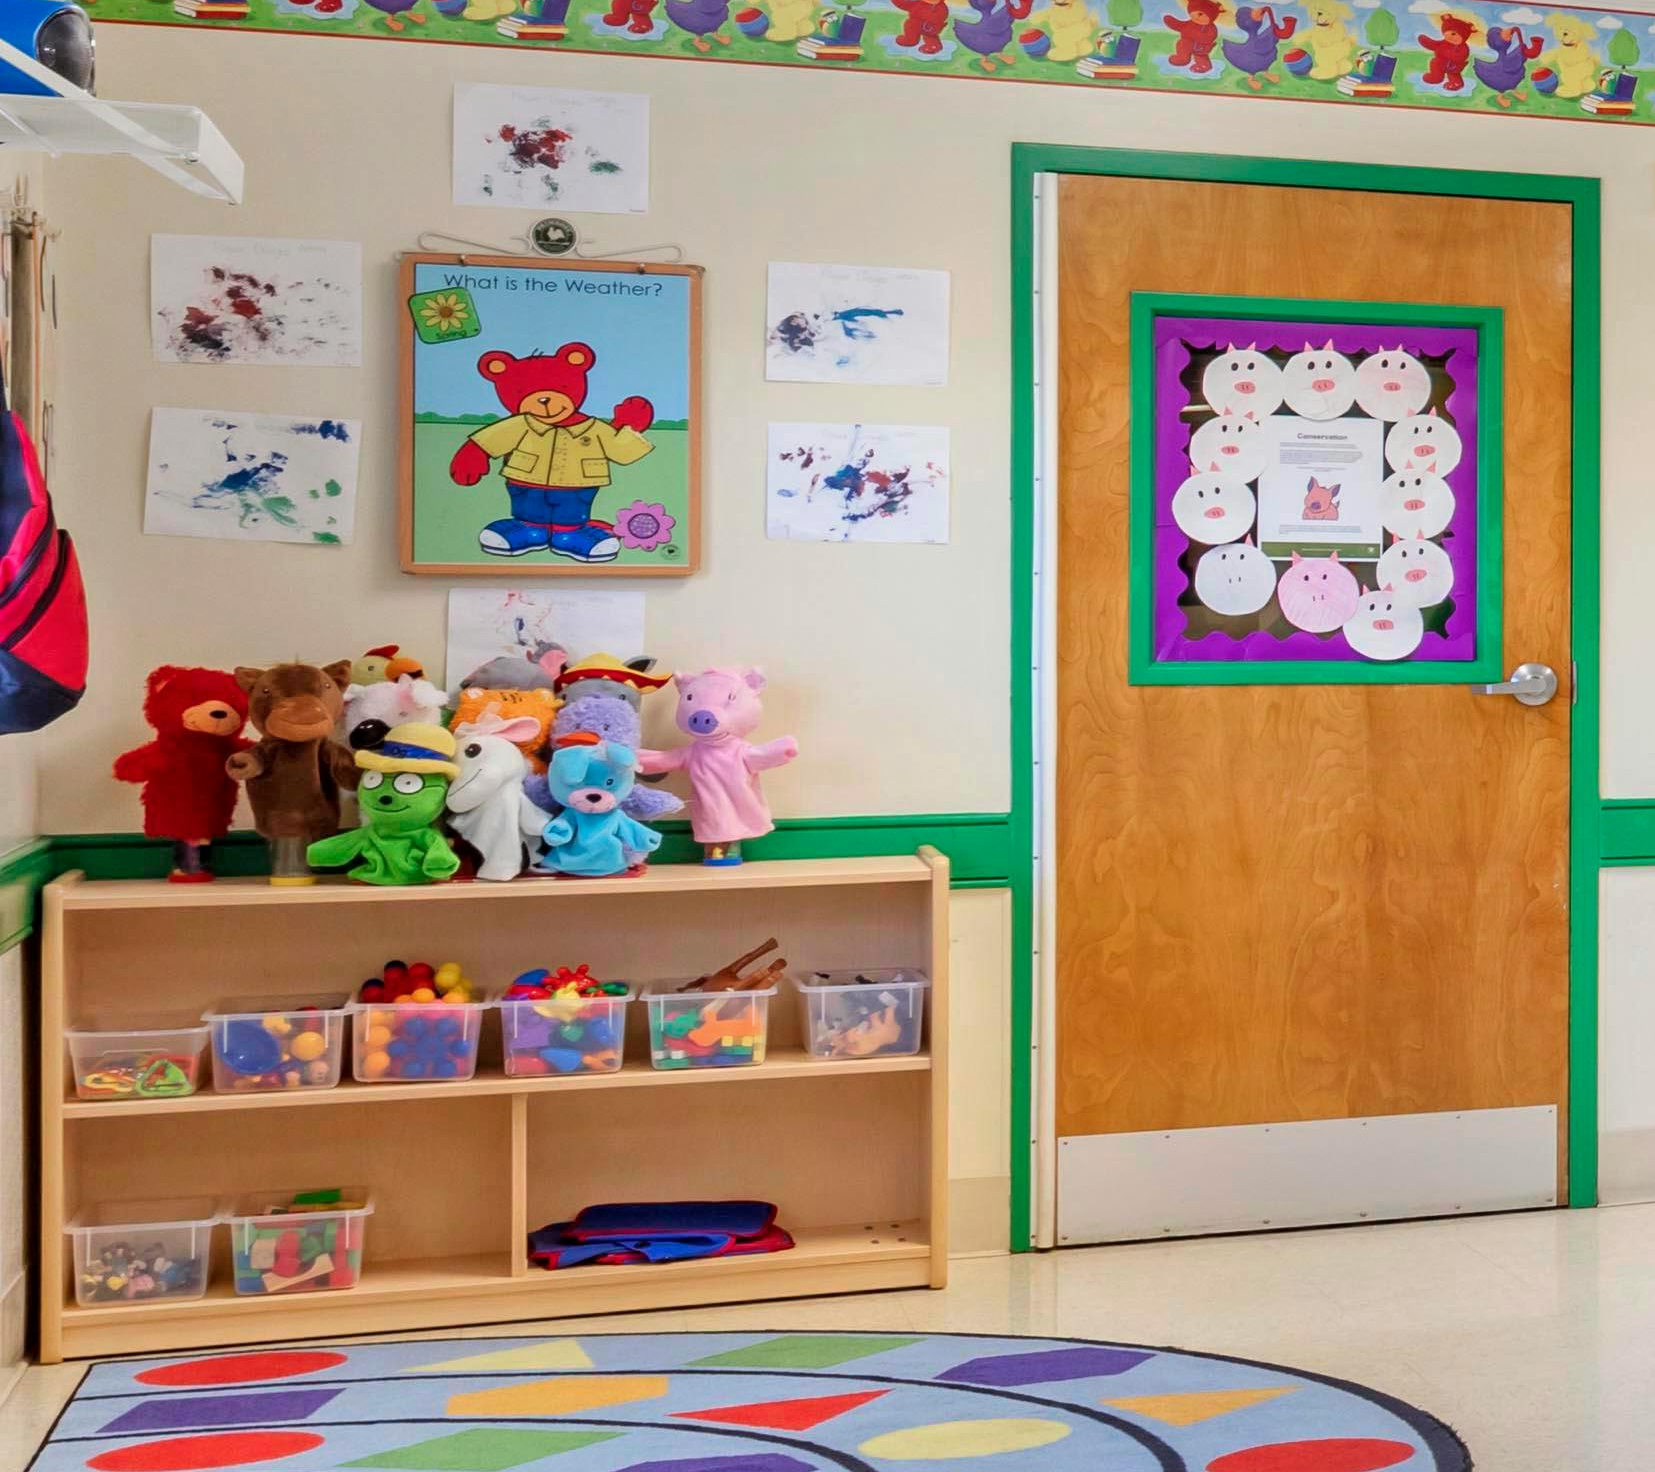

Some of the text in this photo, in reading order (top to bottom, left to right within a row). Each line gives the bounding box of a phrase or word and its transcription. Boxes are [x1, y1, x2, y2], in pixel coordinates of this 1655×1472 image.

[444, 273, 663, 297] What is the Weather?
[1297, 432, 1348, 441] Conservation
